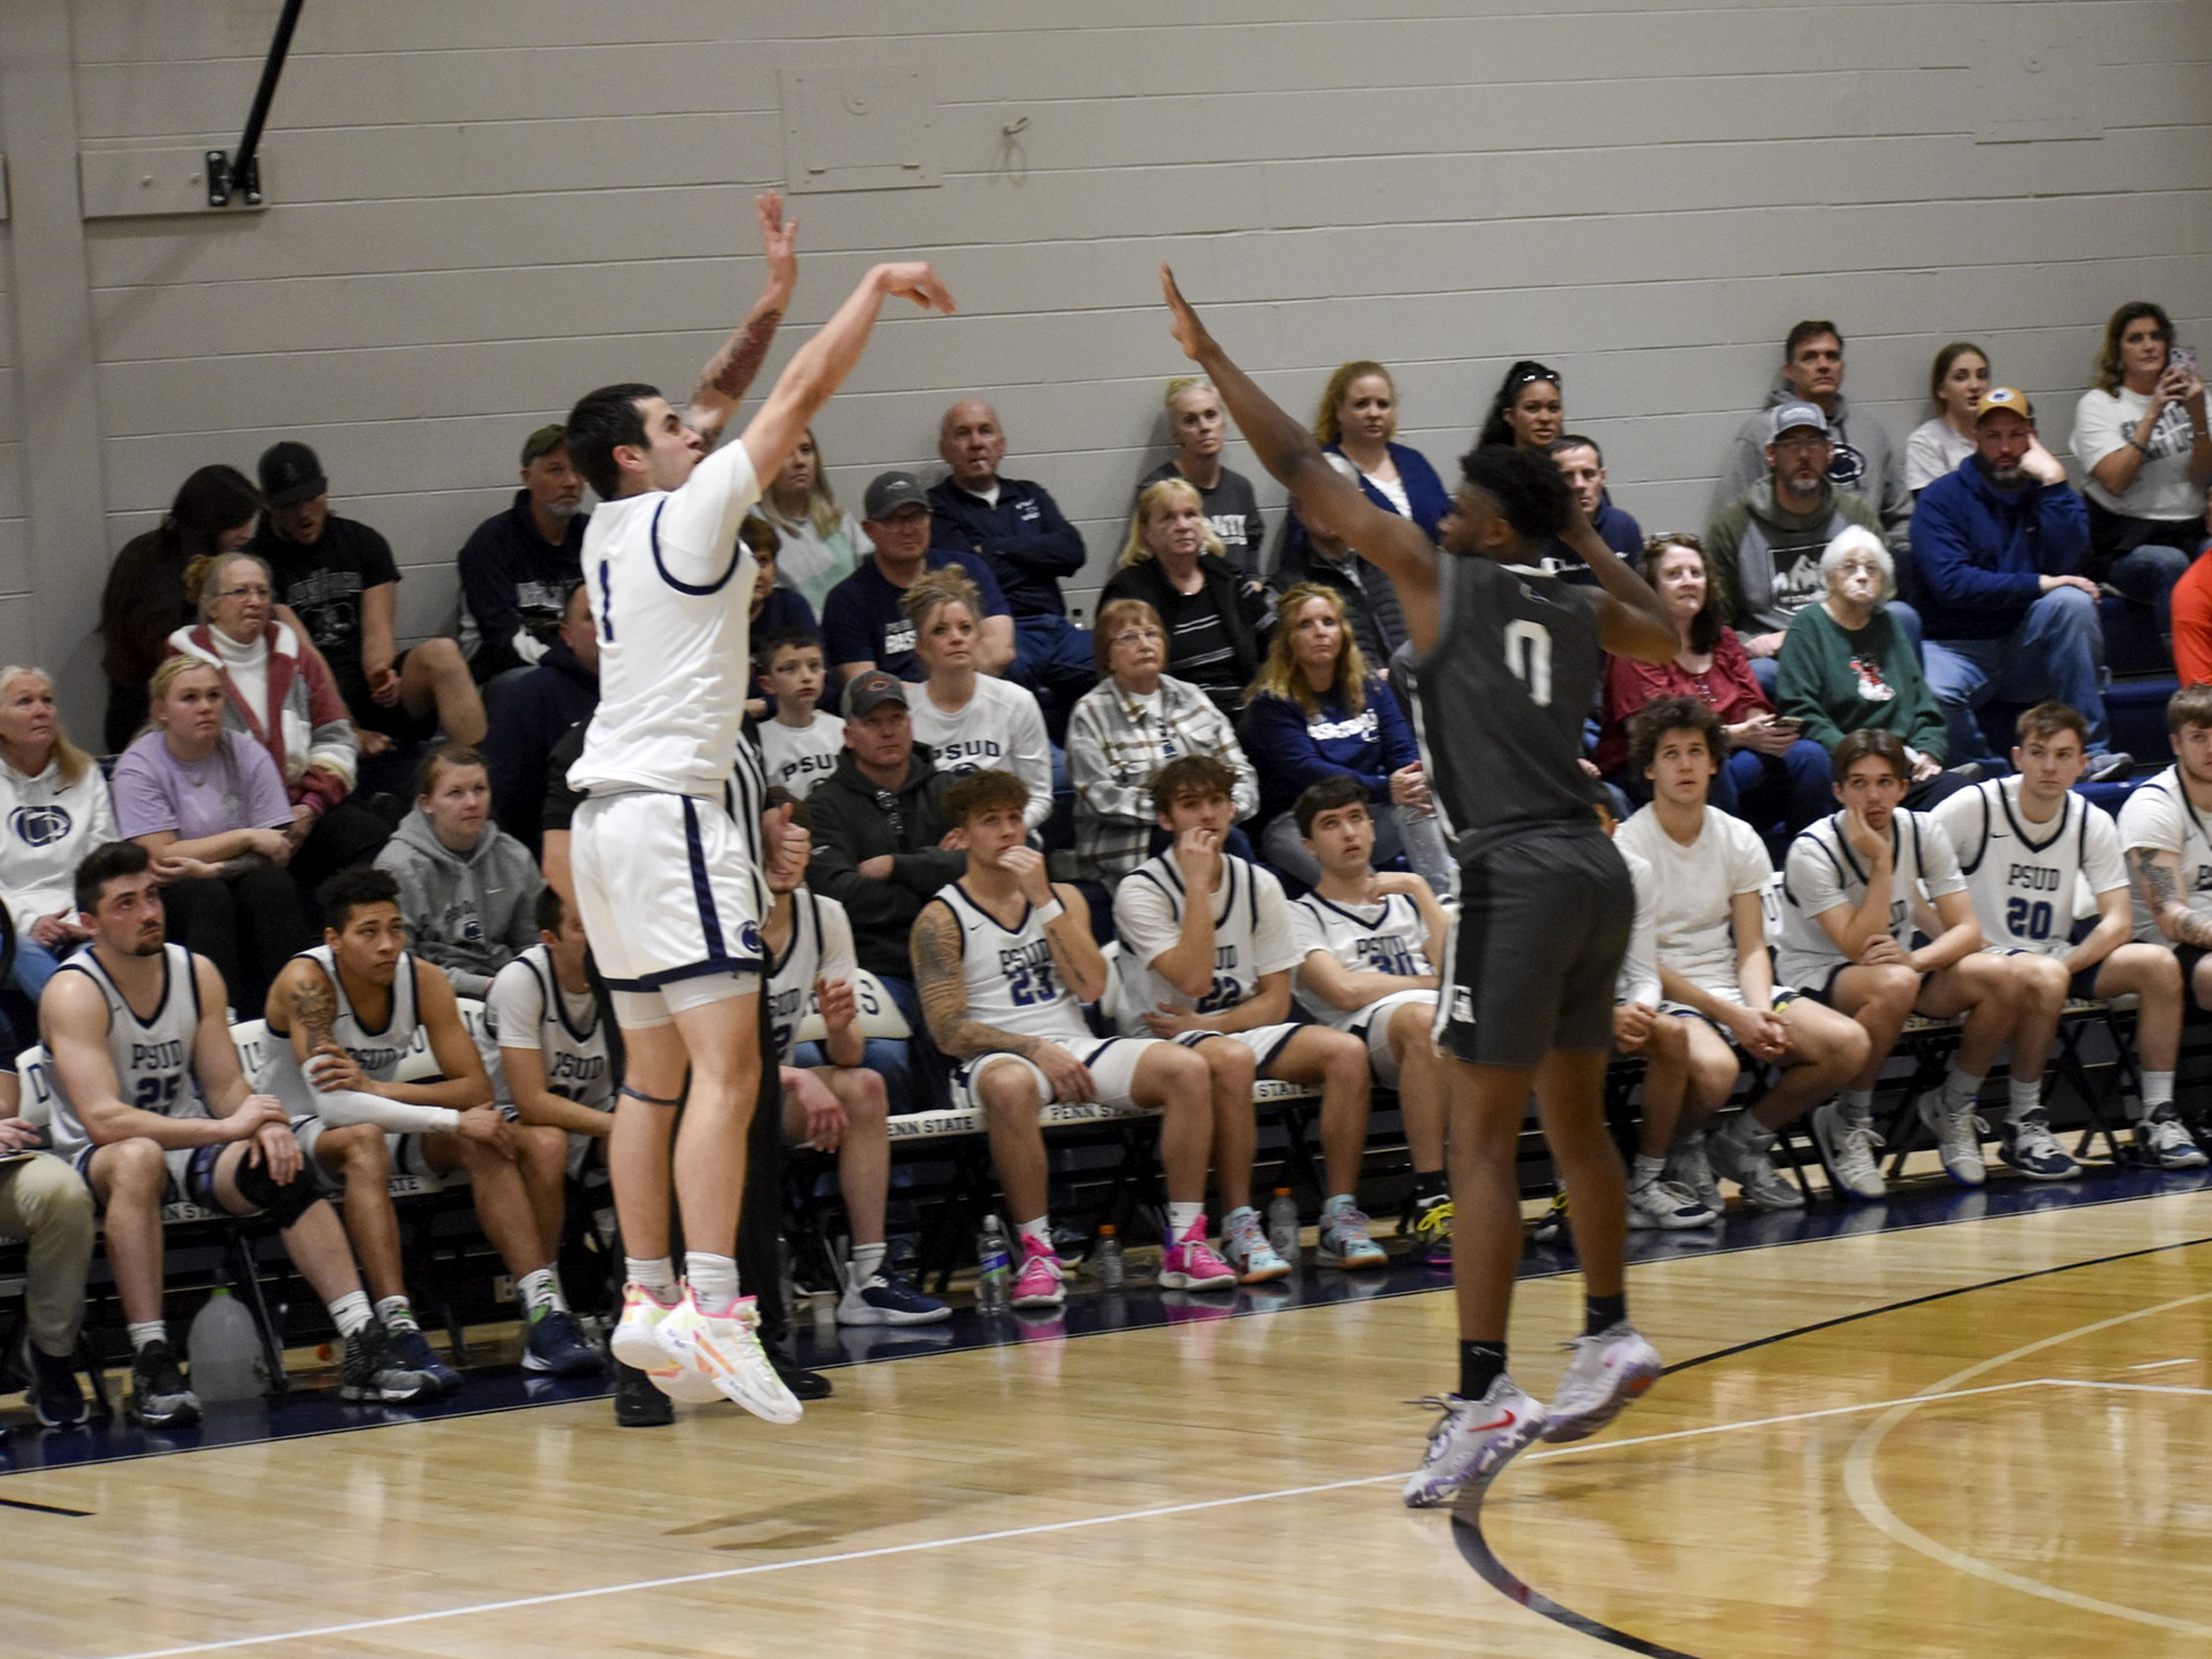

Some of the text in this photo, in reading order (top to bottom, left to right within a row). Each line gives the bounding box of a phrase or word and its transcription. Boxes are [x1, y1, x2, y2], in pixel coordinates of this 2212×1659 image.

[1503, 618, 1553, 707] 0
[781, 753, 835, 782] PSU
[2007, 863, 2061, 892] PSUD
[2006, 896, 2053, 940] 20
[999, 937, 1053, 974] PSUD
[1006, 966, 1056, 1007] 23
[768, 987, 802, 1017] SUD
[131, 1038, 183, 1070] PSUD
[549, 1051, 605, 1080] PSUD
[924, 1115, 975, 1134] STATE
[1051, 1105, 1096, 1121] PENN
[887, 1120, 921, 1136] ENN
